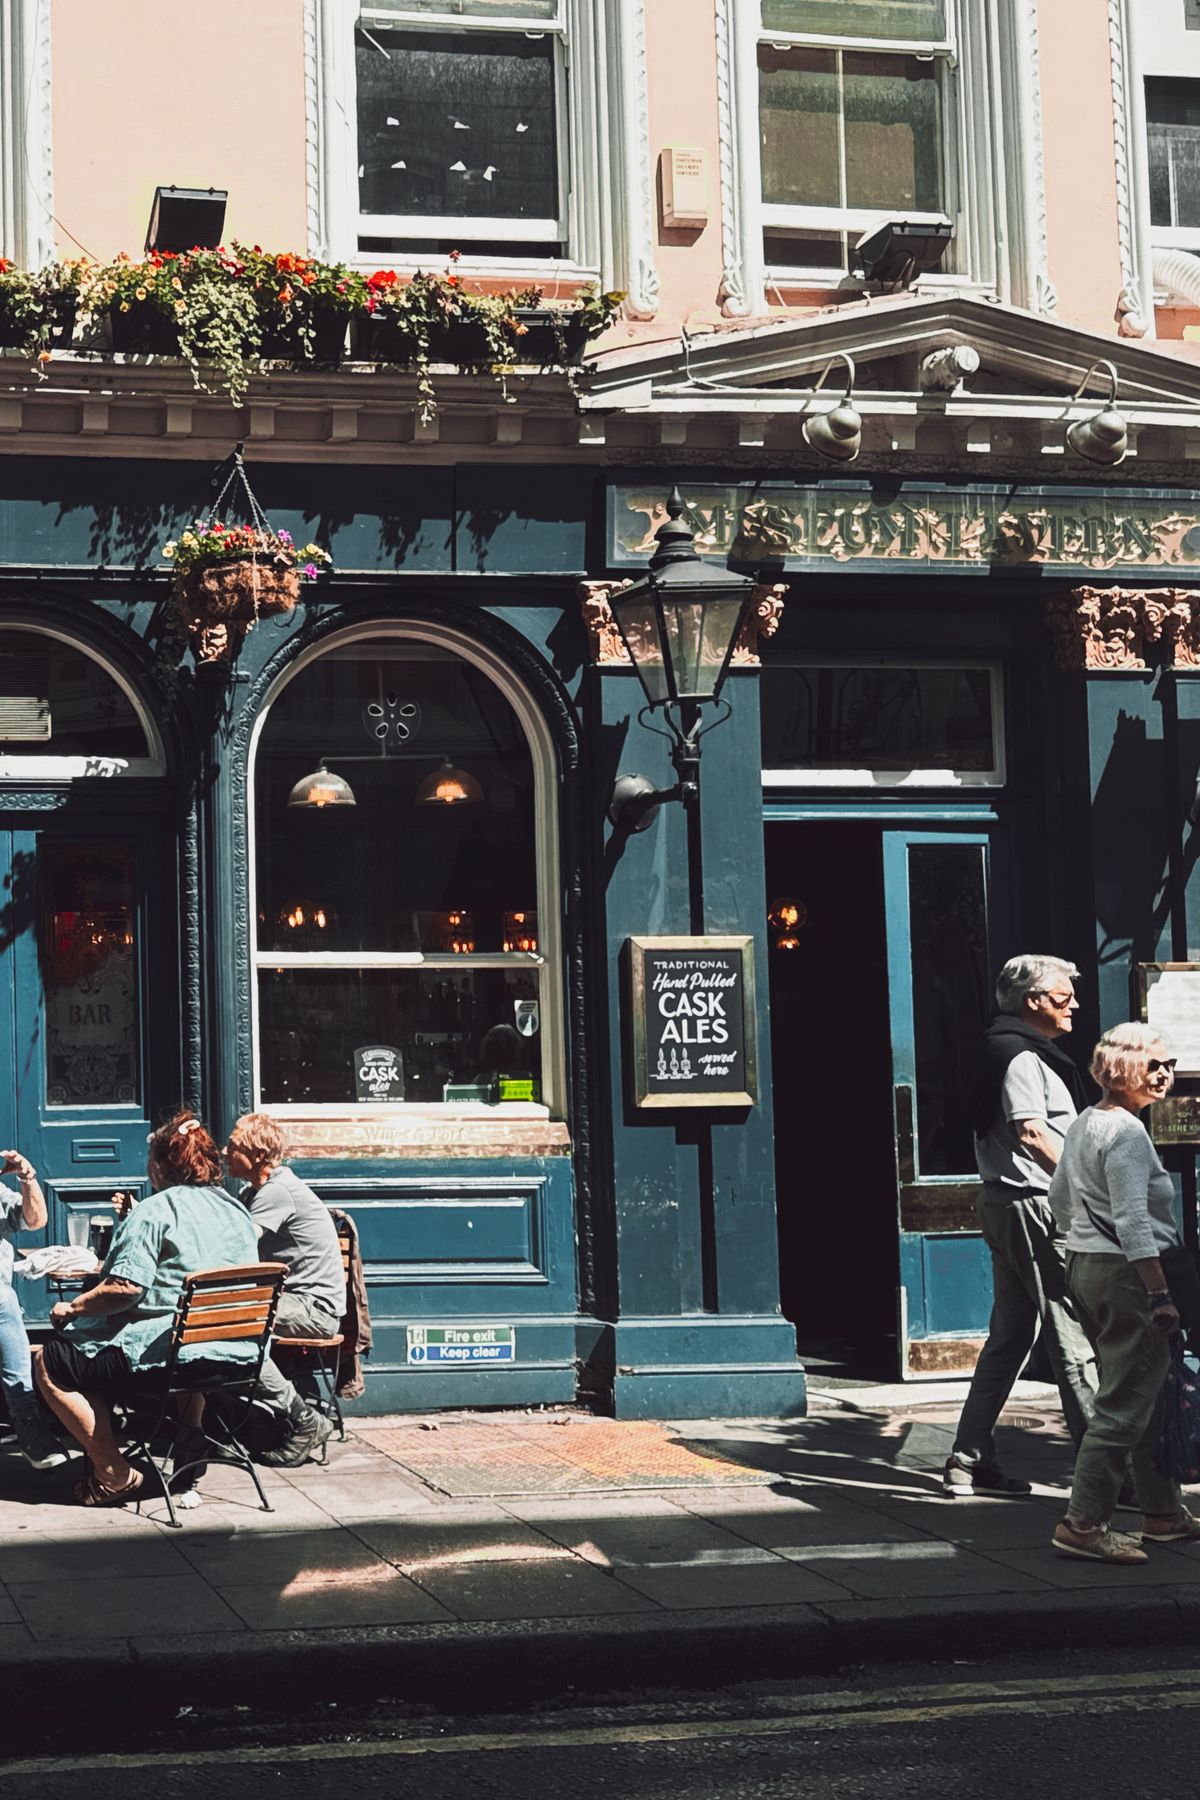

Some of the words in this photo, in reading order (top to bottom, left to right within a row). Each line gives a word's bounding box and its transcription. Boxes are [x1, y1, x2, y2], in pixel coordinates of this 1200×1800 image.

[653, 960, 730, 970] TRADITIONAL
[652, 972, 690, 992] Hand
[689, 972, 737, 990] Pulled
[658, 992, 726, 1018] CASK
[68, 1004, 112, 1025] BAR
[660, 1018, 729, 1044] ALES
[698, 1051, 737, 1064] served
[359, 1066, 400, 1082] CASK
[704, 1064, 729, 1076] here
[444, 1330, 470, 1342] Fire
[472, 1329, 496, 1342] exit
[440, 1347, 470, 1360] Keep
[472, 1346, 501, 1357] clear
